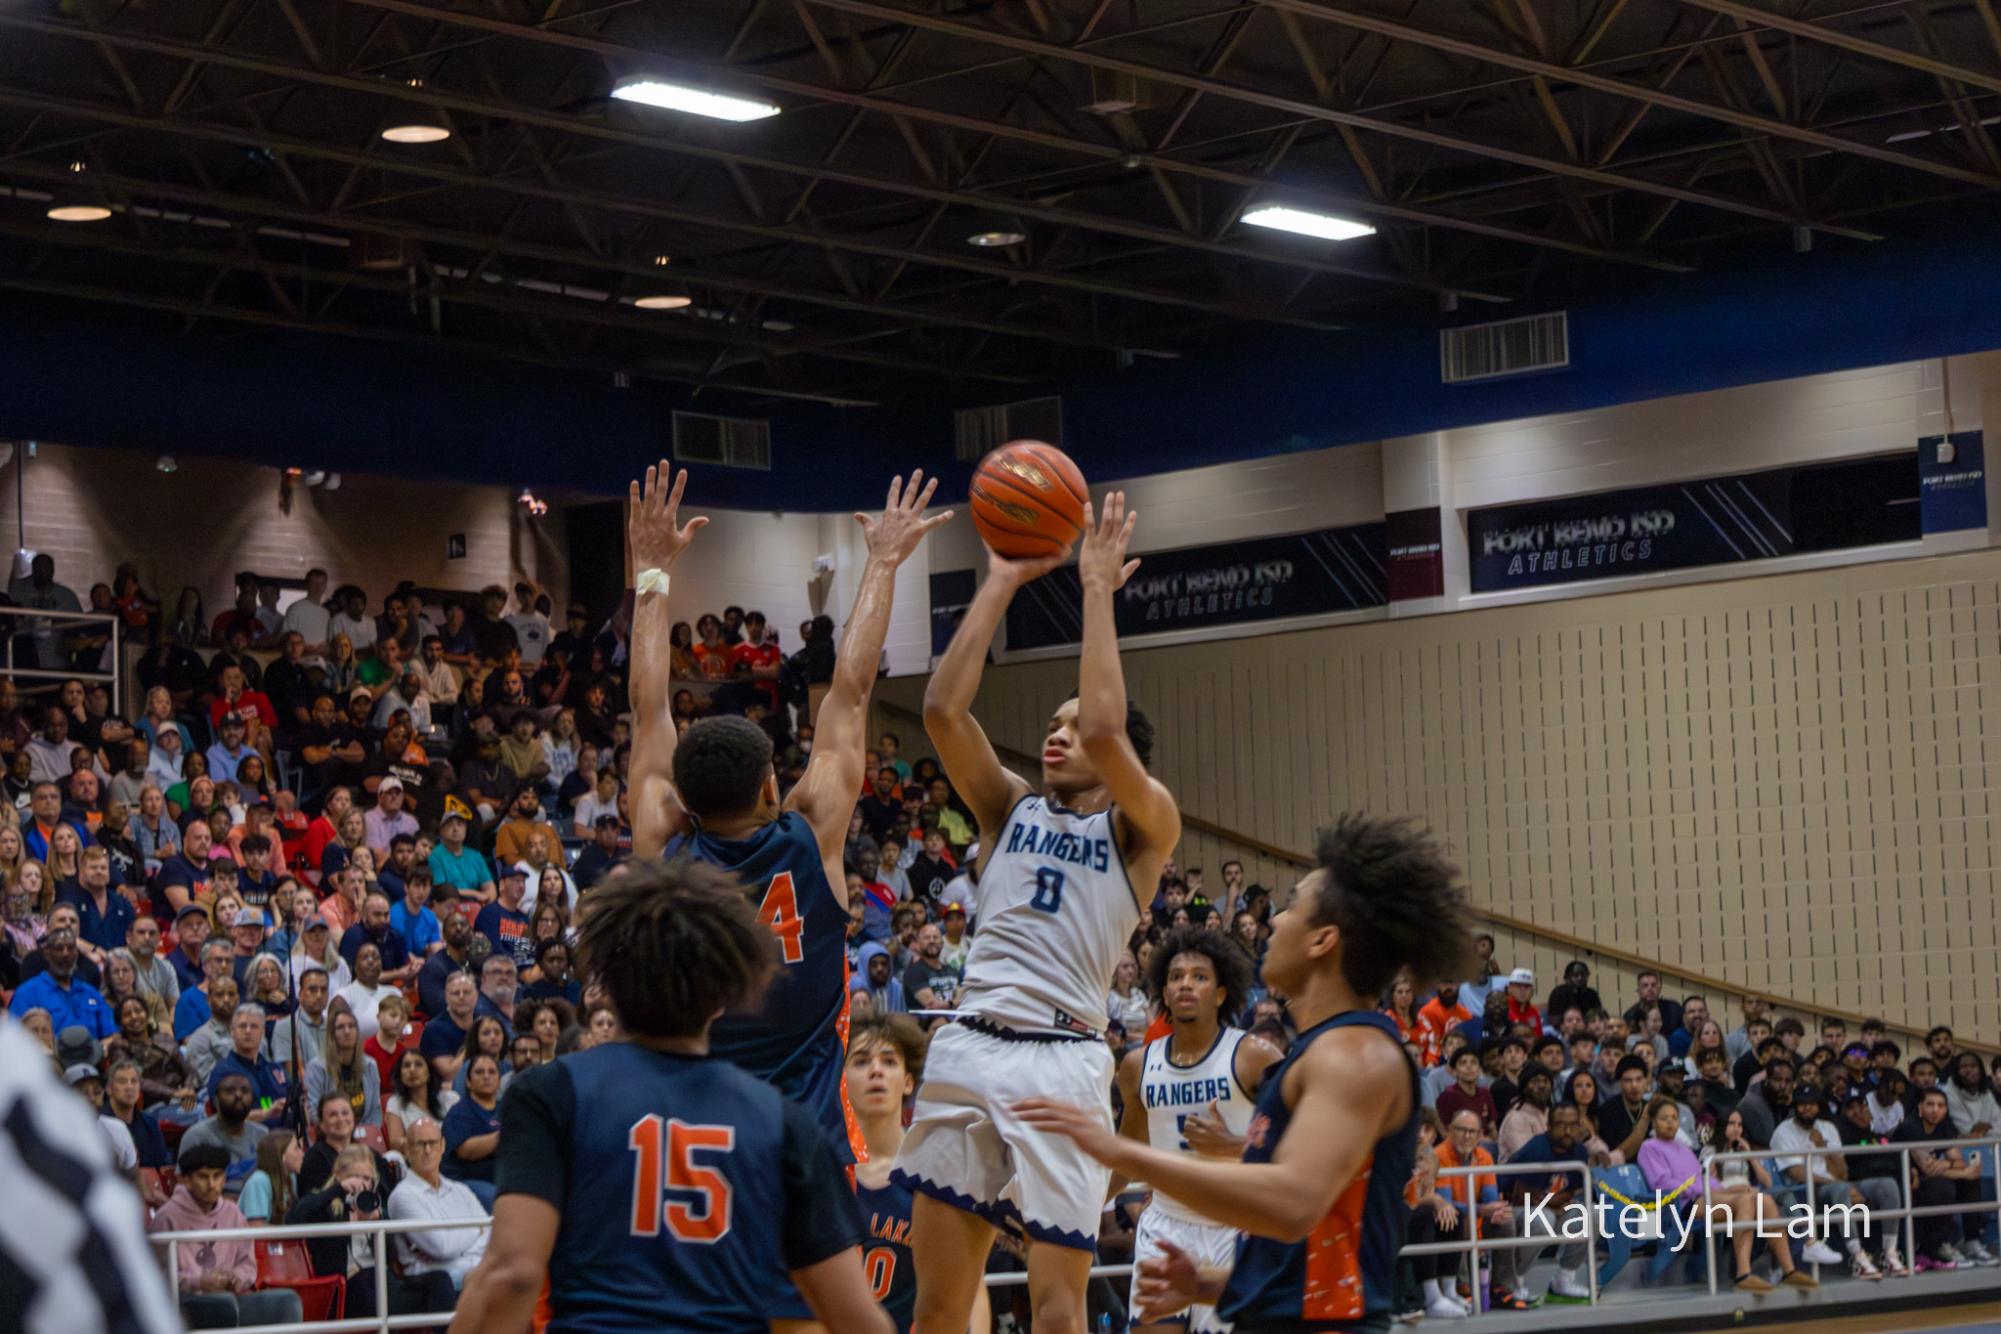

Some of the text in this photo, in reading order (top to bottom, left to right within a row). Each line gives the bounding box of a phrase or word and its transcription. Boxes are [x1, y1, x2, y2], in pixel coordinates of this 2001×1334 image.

[1483, 510, 1676, 556] FORT BEND ISD
[1507, 538, 1652, 576] ATHLETICS
[1146, 587, 1273, 621] ATHLETICS
[1006, 822, 1109, 874] RANGERS
[1030, 866, 1065, 914] 0
[755, 870, 804, 964] 4
[1146, 1077, 1231, 1109] RANGERS
[628, 1112, 736, 1245] 15
